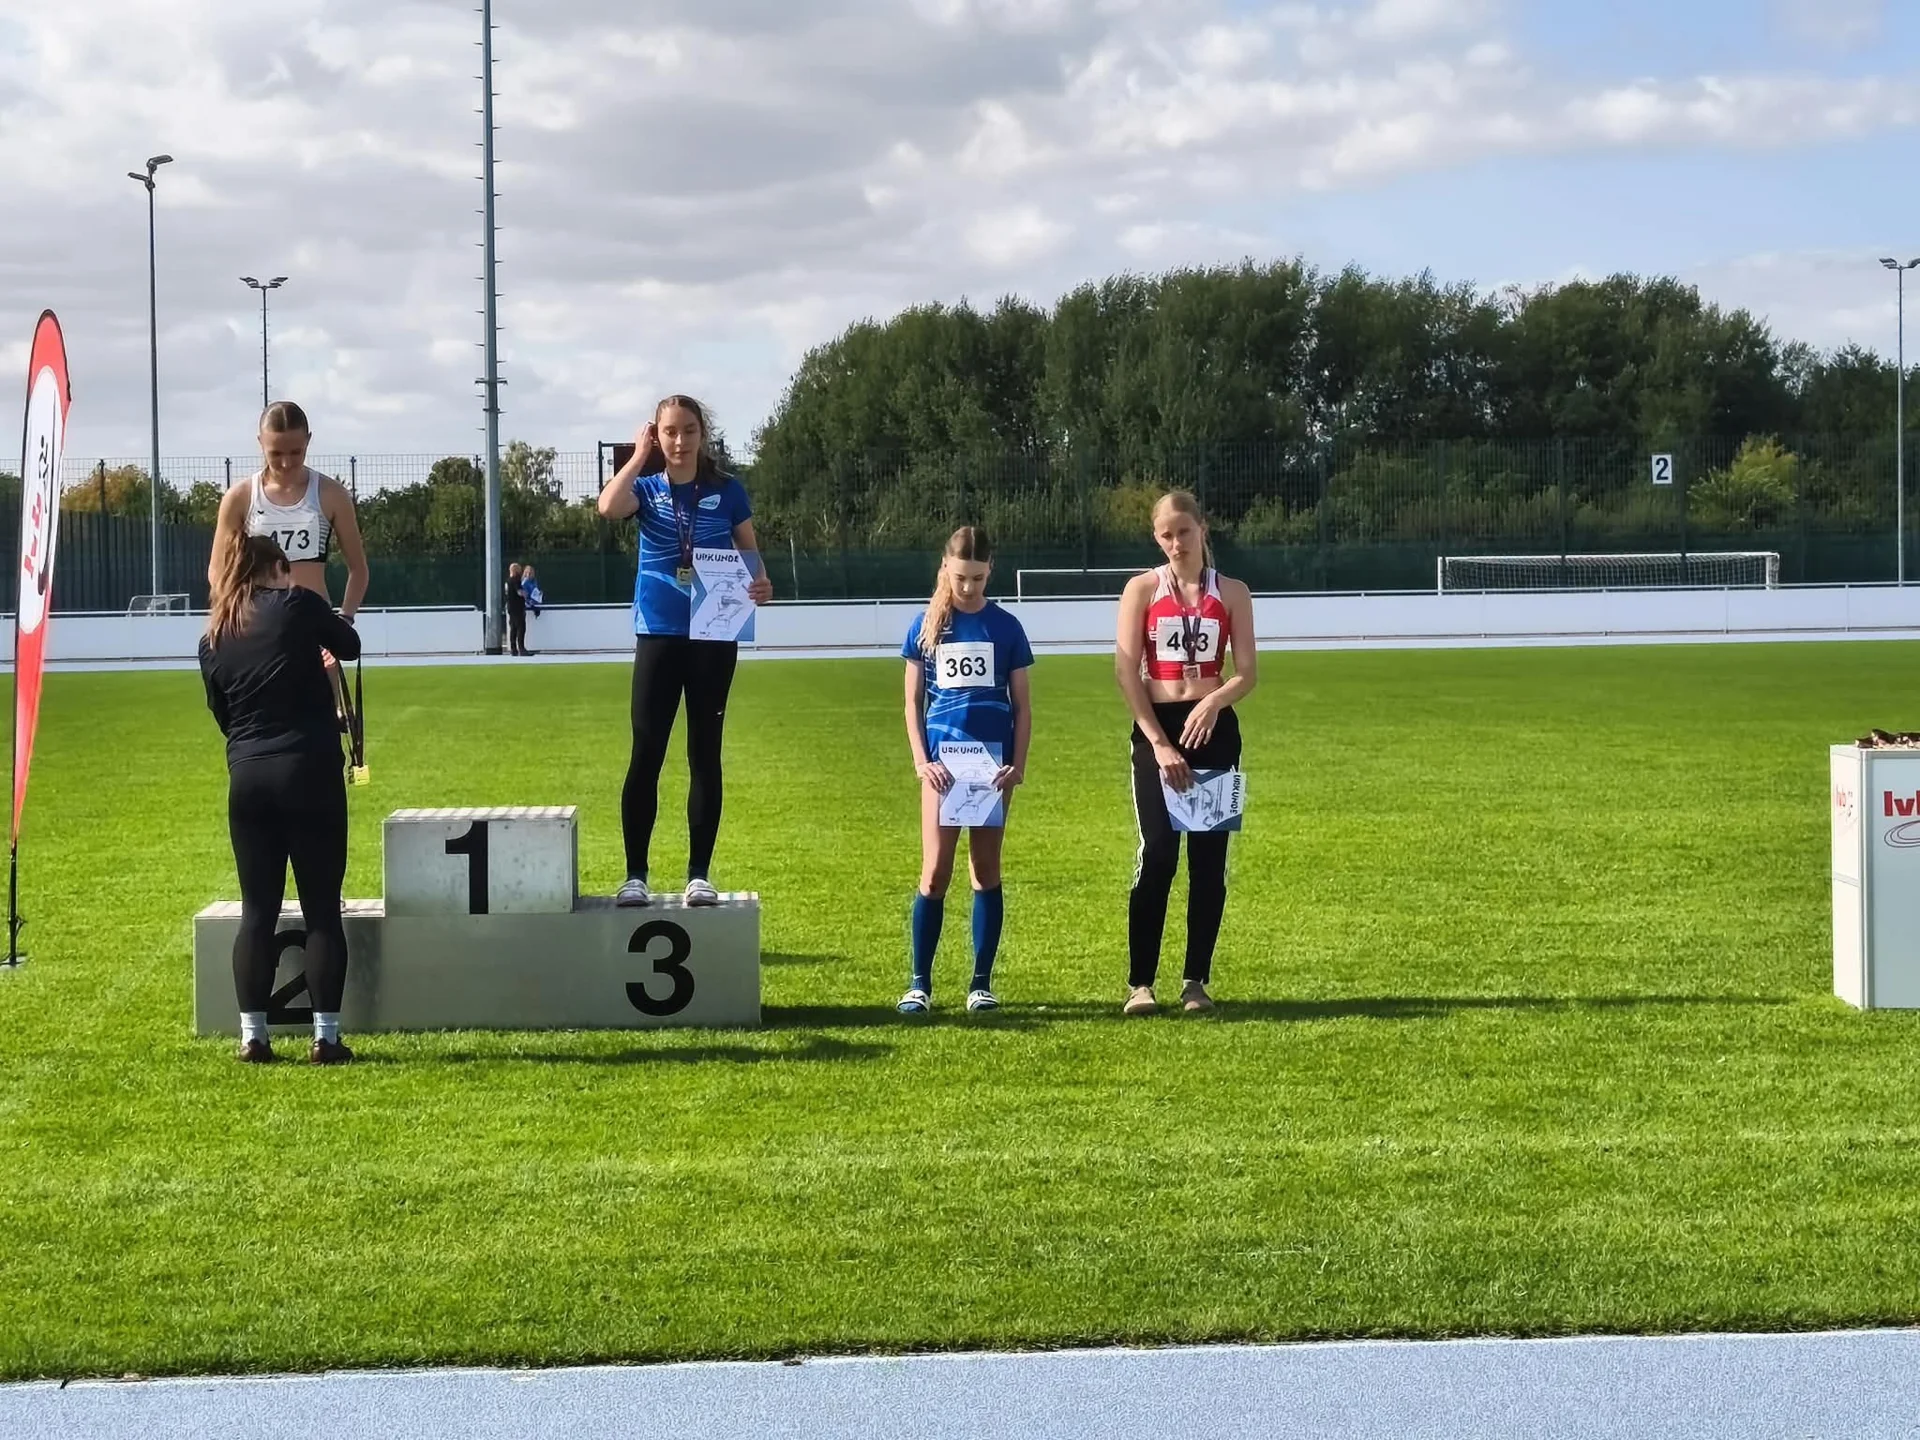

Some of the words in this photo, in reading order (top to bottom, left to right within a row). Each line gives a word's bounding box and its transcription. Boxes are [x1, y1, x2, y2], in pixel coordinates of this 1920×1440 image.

[1655, 457, 1669, 480] 2
[695, 552, 740, 563] URKUNDE
[945, 656, 987, 678] 363
[1883, 790, 1920, 817] lv
[445, 821, 489, 915] 1
[625, 919, 696, 1017] 3
